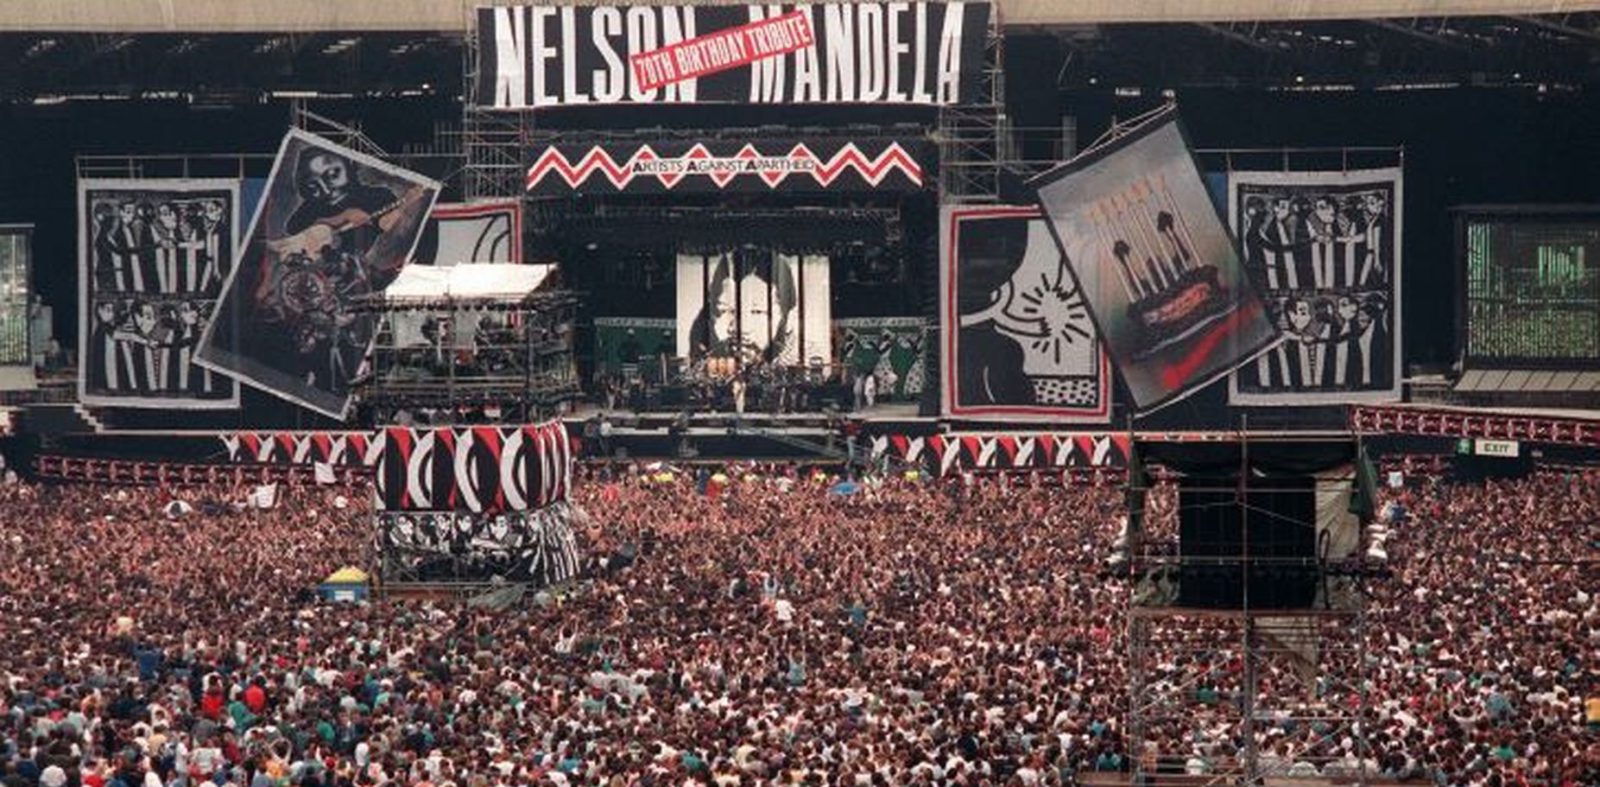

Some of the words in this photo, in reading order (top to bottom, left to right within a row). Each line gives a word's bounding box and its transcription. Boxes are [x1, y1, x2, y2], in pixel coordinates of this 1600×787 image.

[494, 5, 696, 109] NELSON
[749, 2, 964, 105] MANDELA
[636, 52, 675, 86] 70TH
[674, 31, 748, 75] BIRTHDAY
[746, 15, 811, 55] TRIBUTE
[632, 161, 682, 173] ARTISTS
[686, 160, 743, 172] AGAINST
[745, 159, 815, 171] APARTHEID
[1484, 443, 1510, 453] EXIT
